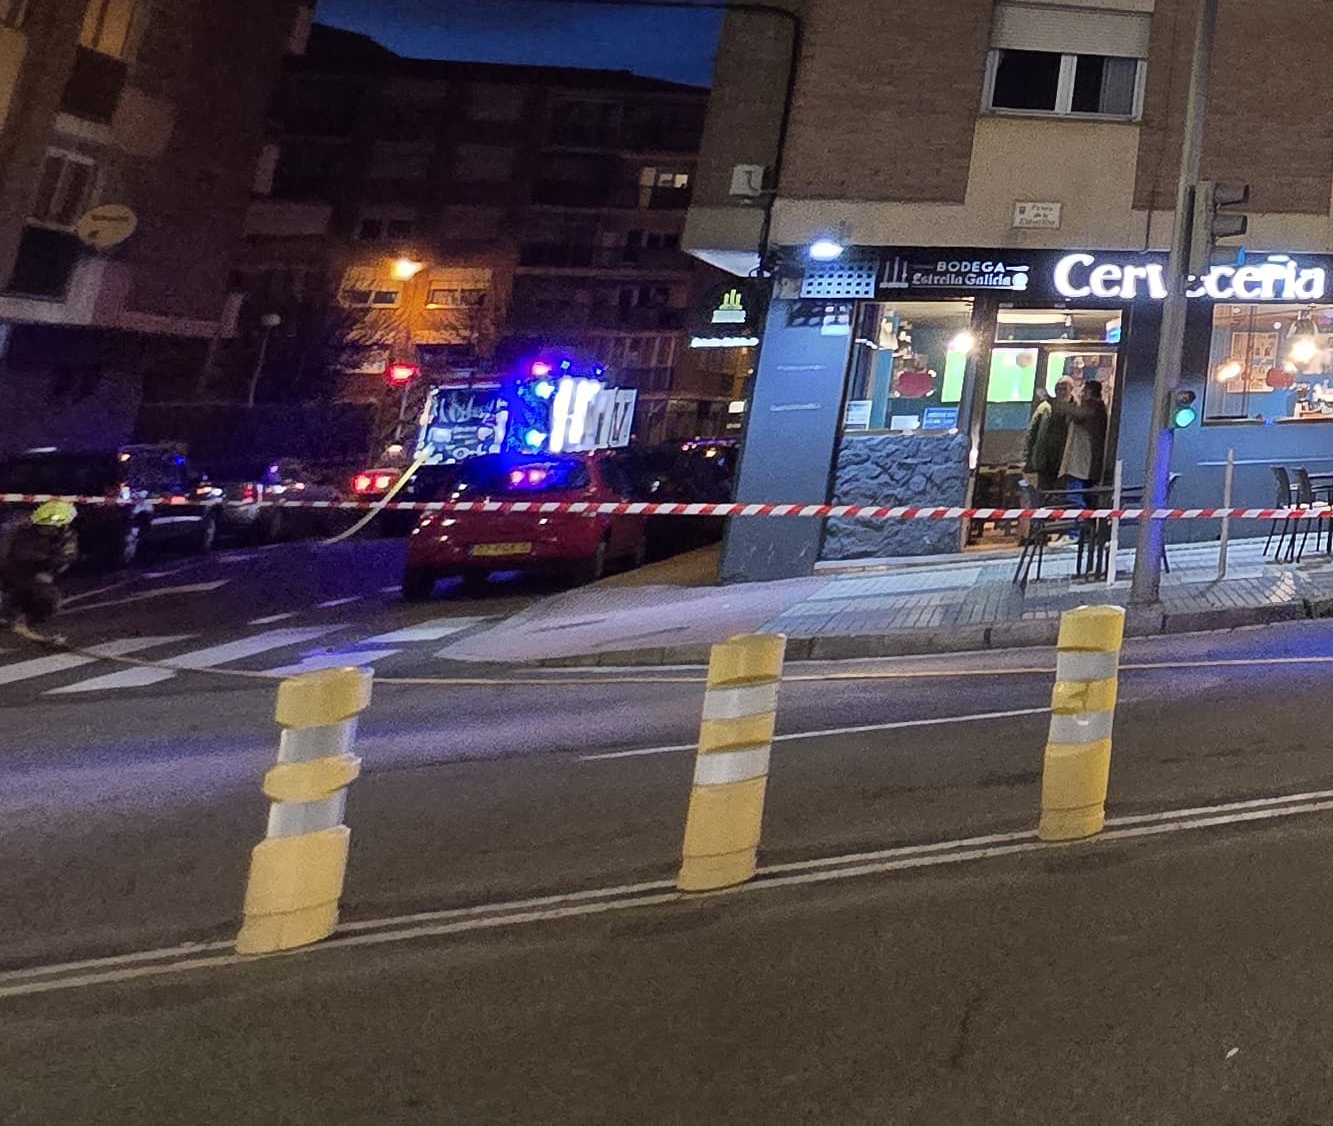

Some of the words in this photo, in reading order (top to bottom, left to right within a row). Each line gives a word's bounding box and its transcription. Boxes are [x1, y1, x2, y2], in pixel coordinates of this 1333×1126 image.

[936, 261, 1006, 273] BODEGA
[911, 273, 962, 285] Estrella
[964, 273, 1011, 286] Galicia
[1053, 253, 1325, 299] Cervcería
